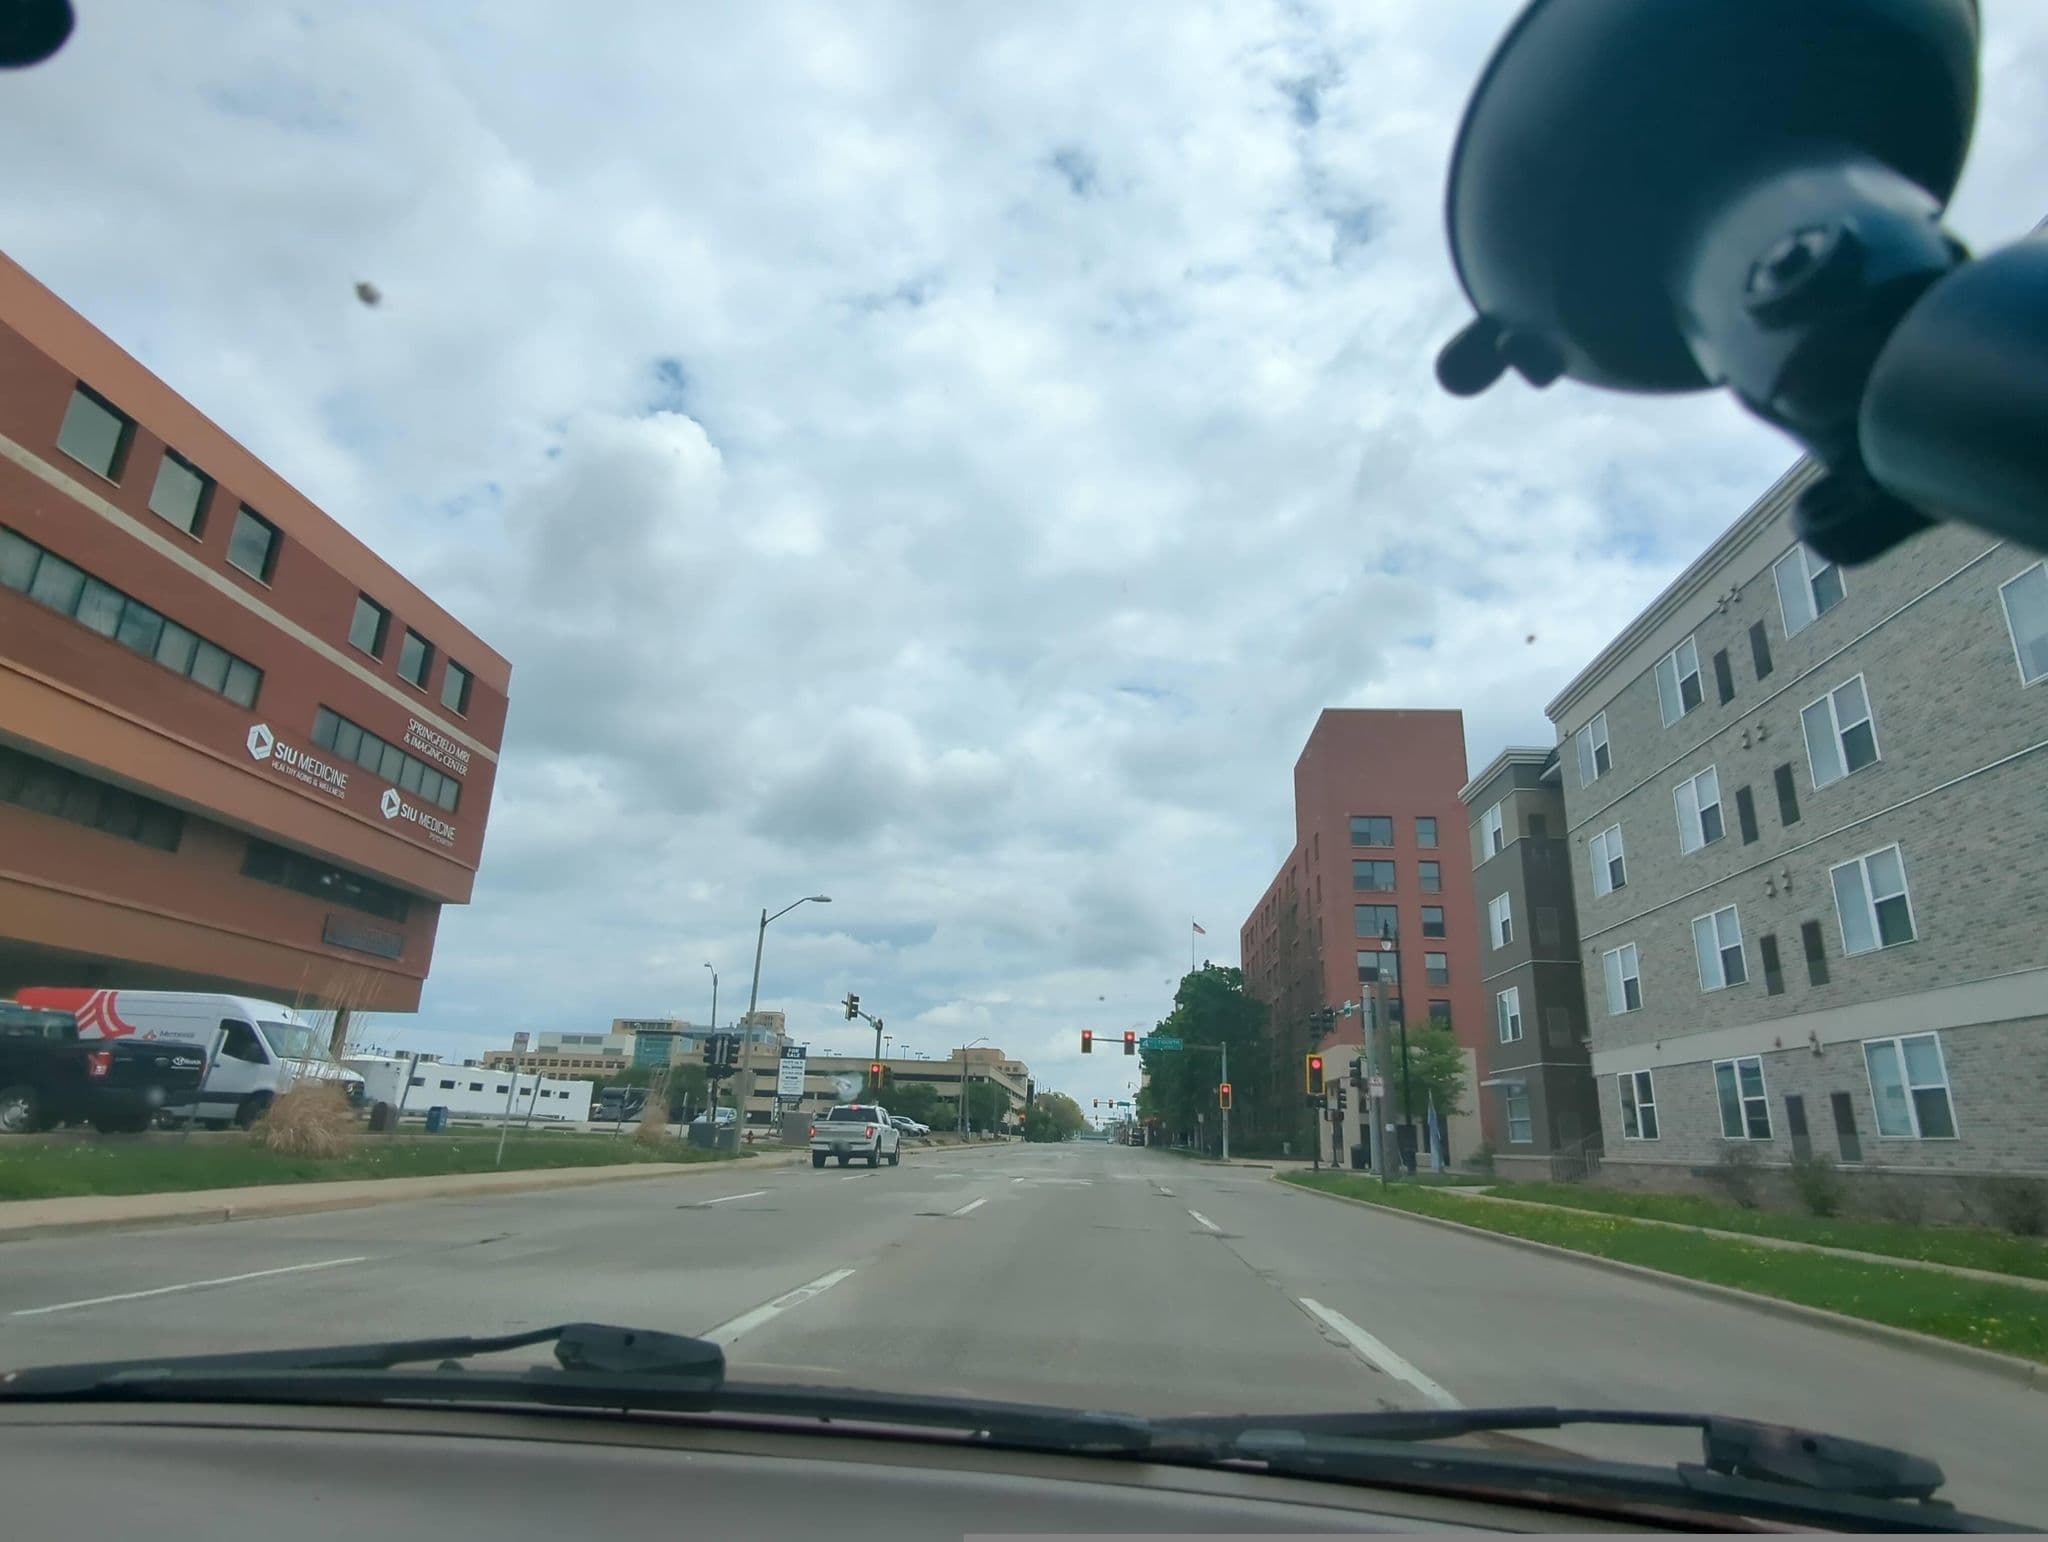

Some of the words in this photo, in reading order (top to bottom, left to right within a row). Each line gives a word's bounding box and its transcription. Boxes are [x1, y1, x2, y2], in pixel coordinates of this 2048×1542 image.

[403, 732, 411, 744] &
[410, 736, 443, 762] IMAGING
[442, 755, 468, 776] CENTER
[407, 718, 456, 755] SPRINGFIELD
[455, 747, 471, 763] MRI
[271, 759, 298, 778] HEALTHY
[318, 781, 345, 800] WELLNESS
[274, 741, 298, 765] SIU
[298, 753, 349, 790] MEDICINE
[400, 803, 418, 822] SIU
[418, 811, 456, 841] MEDICINE
